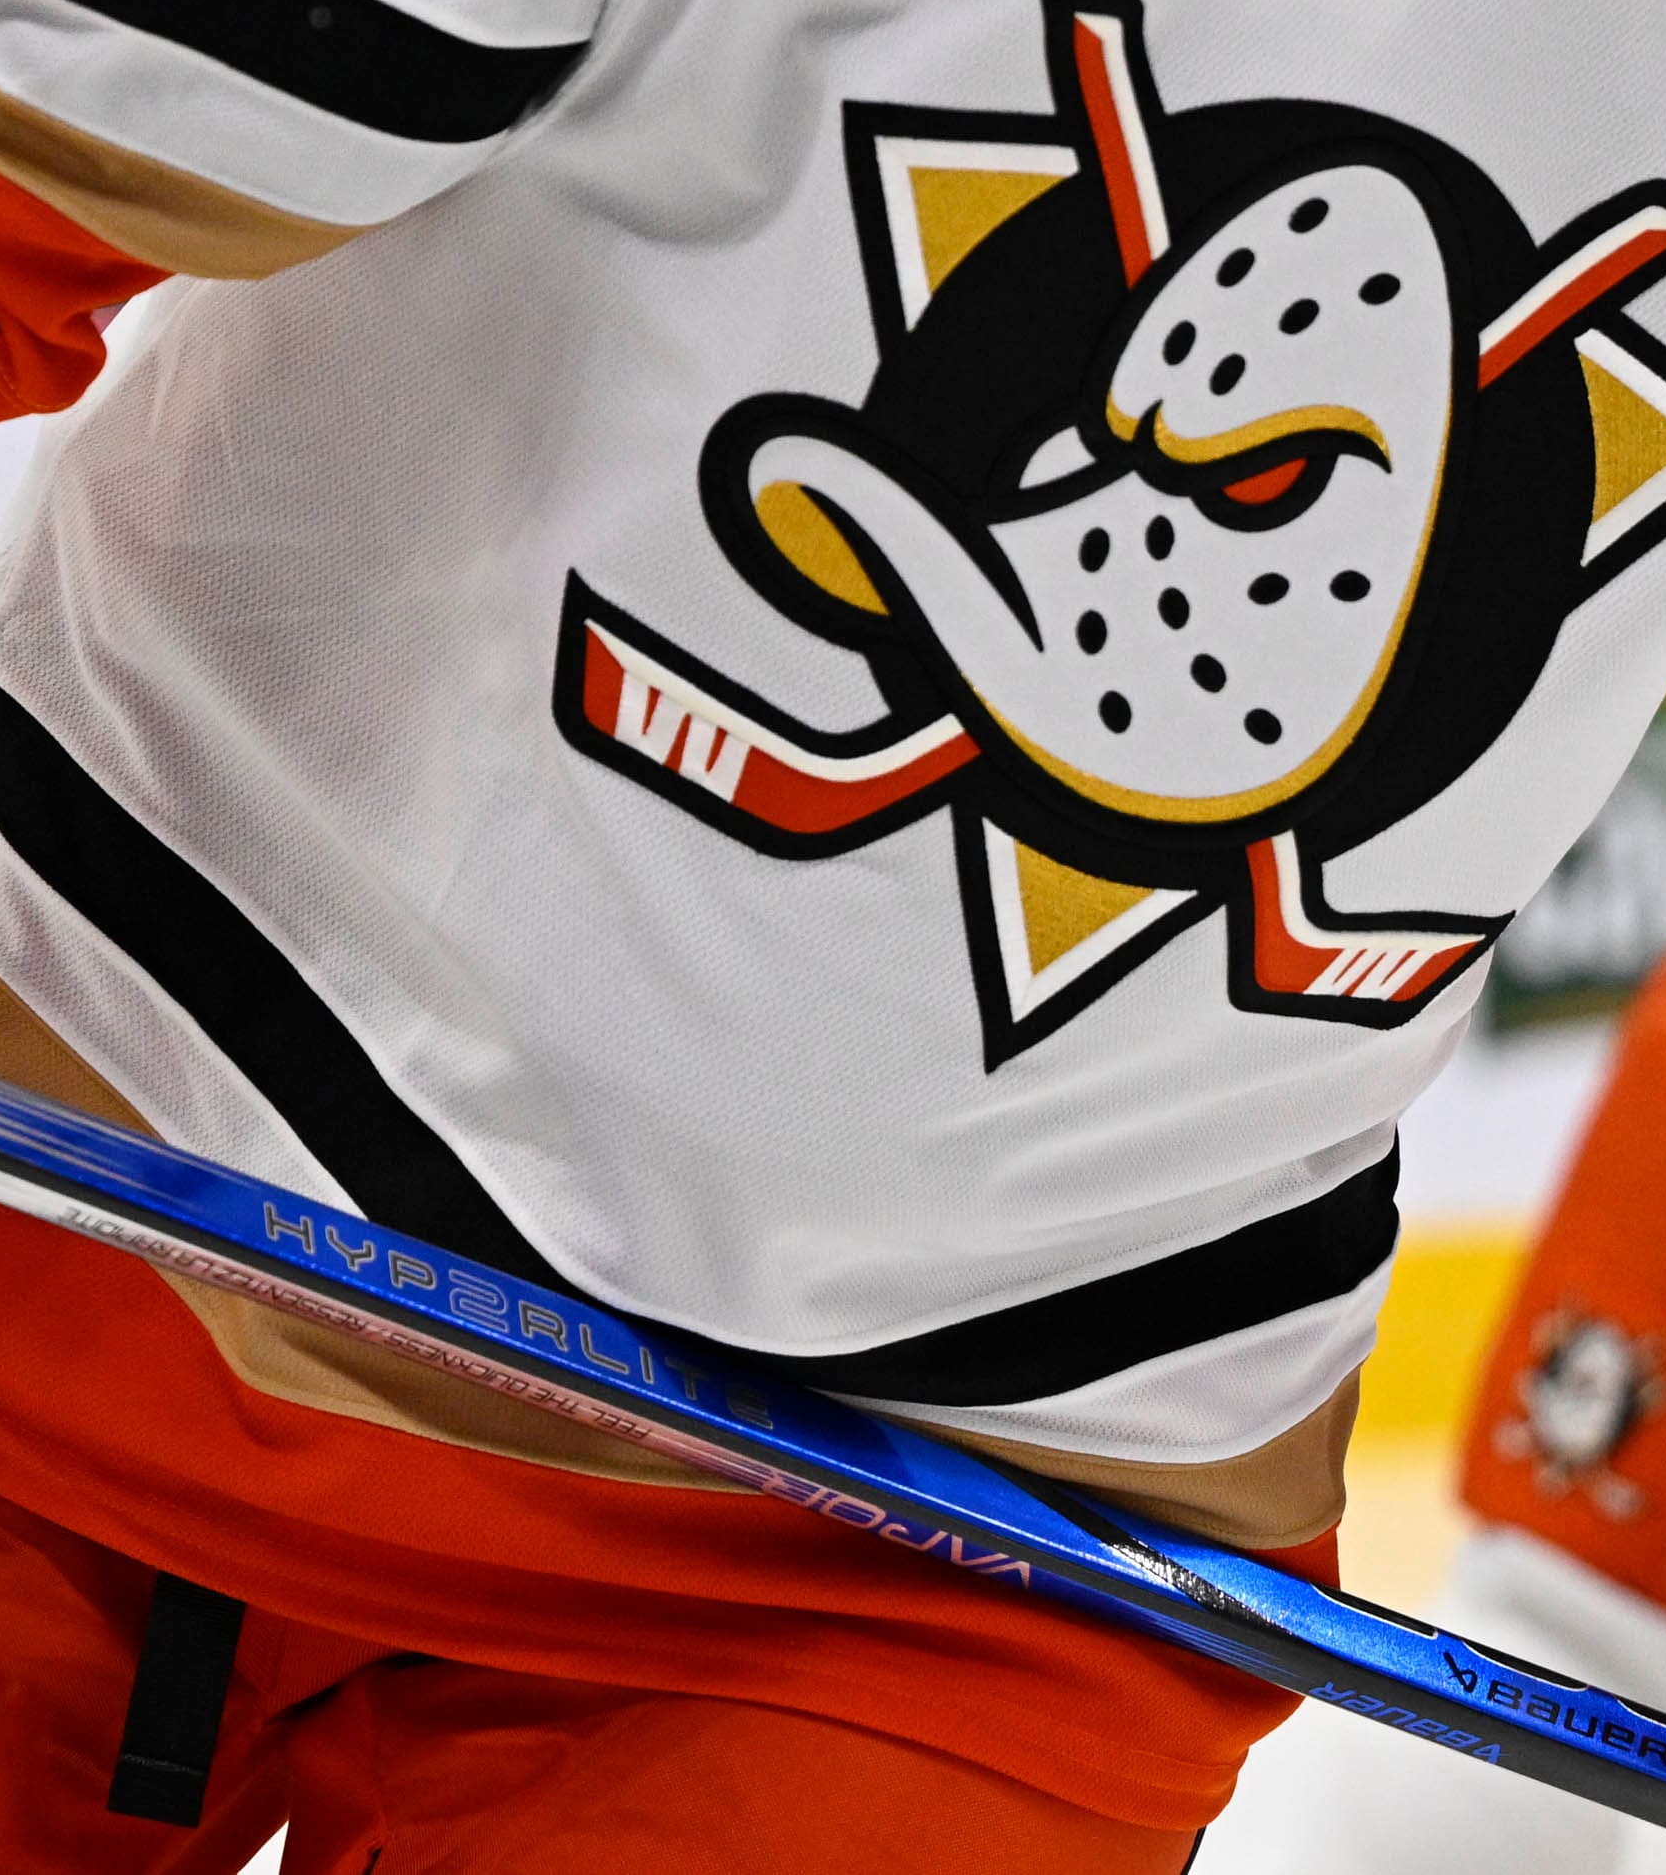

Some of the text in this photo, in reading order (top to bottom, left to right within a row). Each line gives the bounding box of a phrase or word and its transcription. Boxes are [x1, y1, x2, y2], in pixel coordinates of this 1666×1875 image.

[389, 1332, 531, 1393] QUICKNESS
[532, 1387, 580, 1417] THE
[590, 1407, 653, 1439] FEEL
[762, 1469, 1031, 1590] VAPOR
